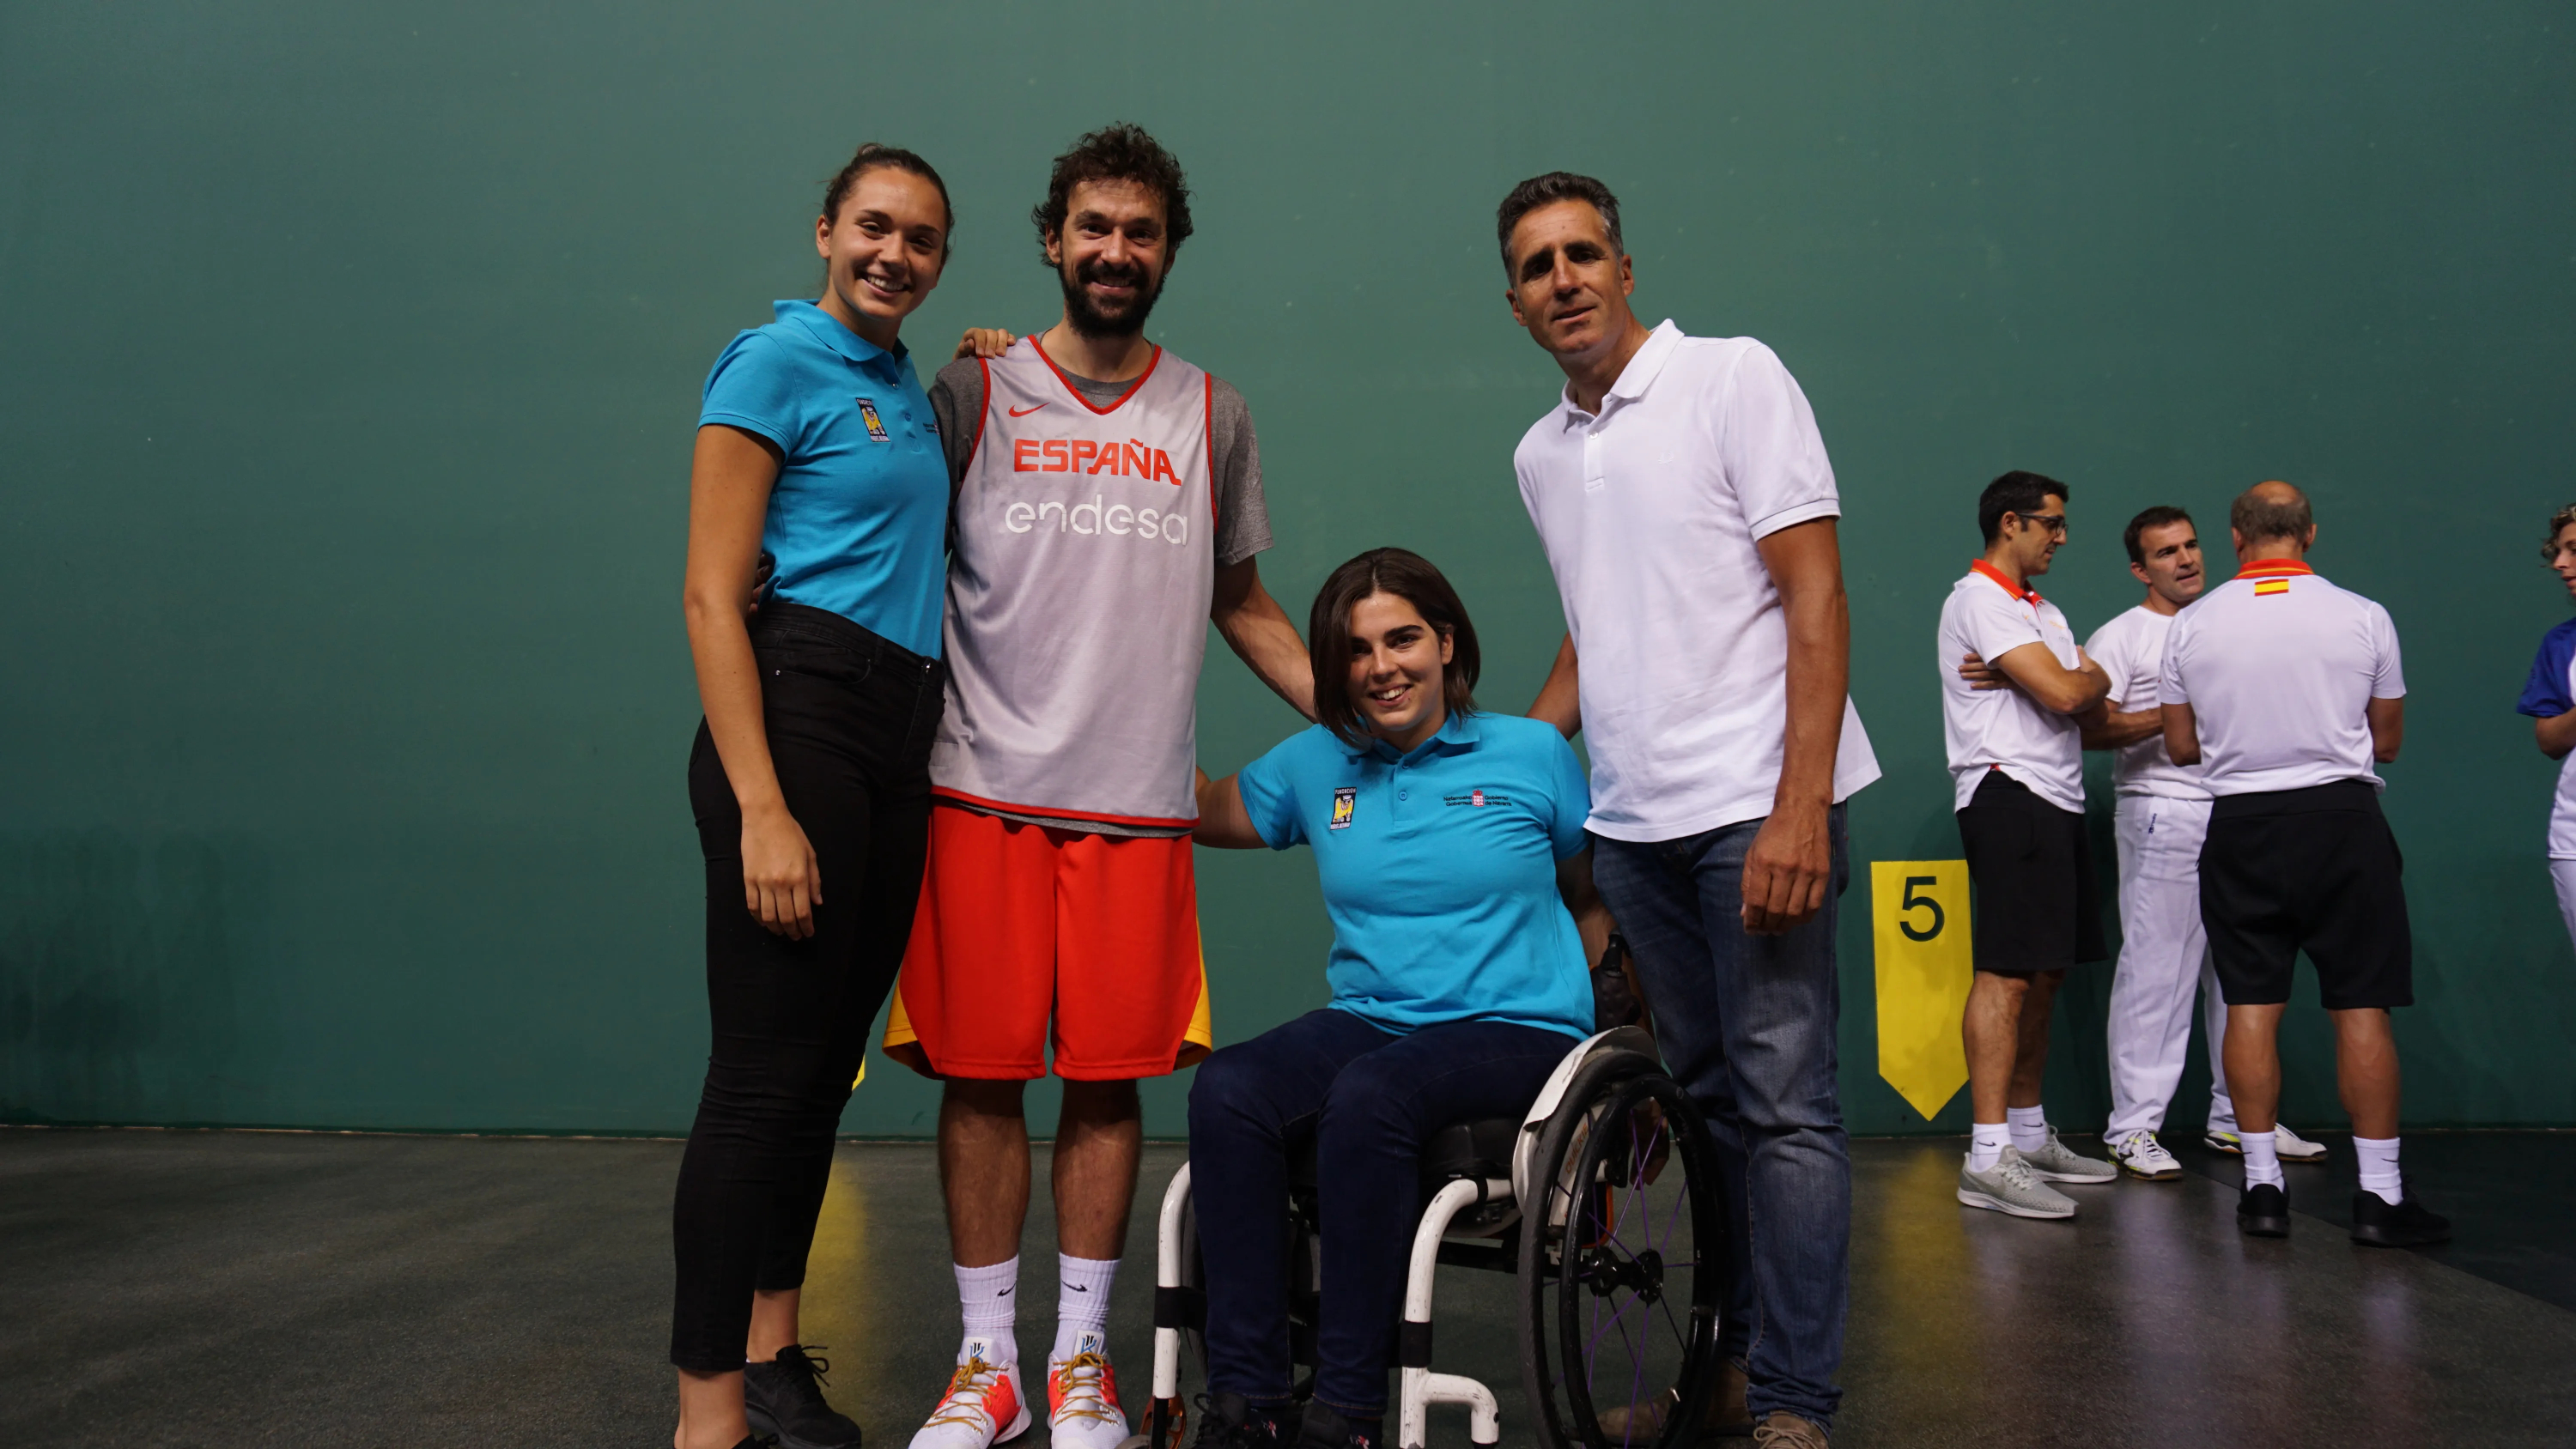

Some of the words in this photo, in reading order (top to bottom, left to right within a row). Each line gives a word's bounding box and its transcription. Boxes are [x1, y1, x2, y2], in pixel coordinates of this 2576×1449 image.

[1013, 438, 1182, 486] ESPAÑA
[1005, 494, 1188, 546] endesa
[1899, 876, 1945, 943] 5
